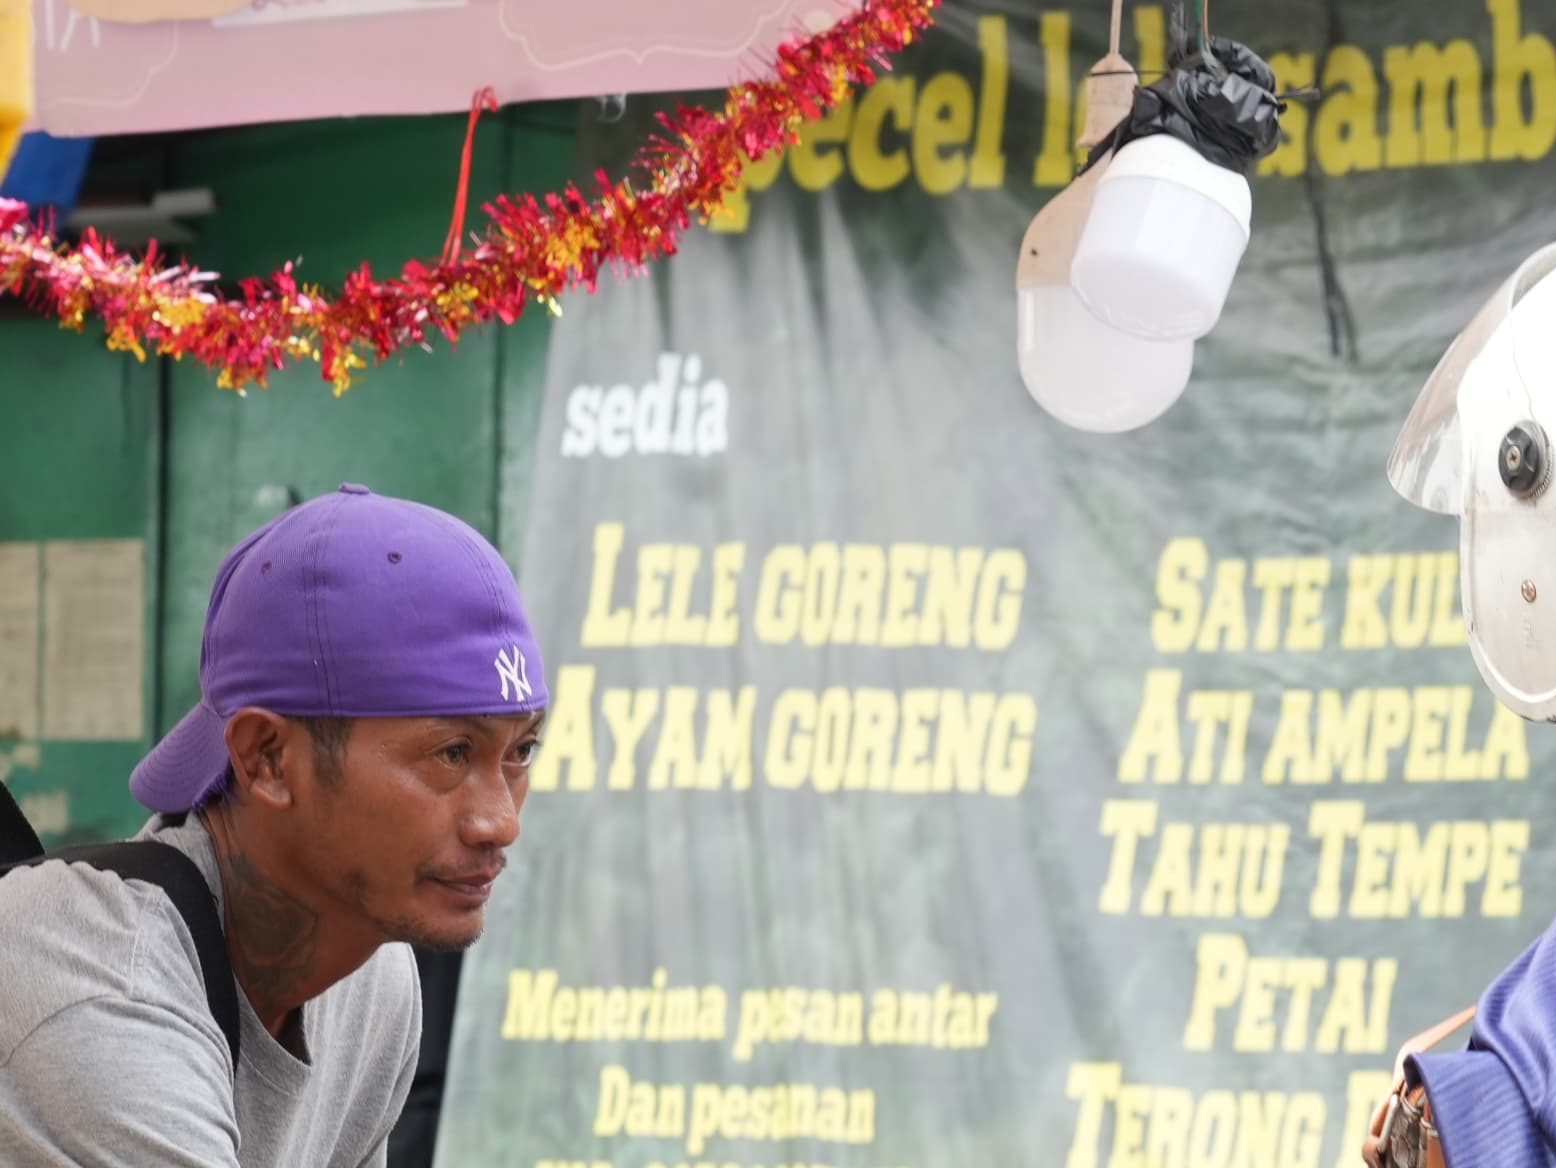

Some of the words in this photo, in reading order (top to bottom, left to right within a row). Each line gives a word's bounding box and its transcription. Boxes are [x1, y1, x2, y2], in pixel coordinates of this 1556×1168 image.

[561, 352, 729, 458] sedia
[580, 522, 745, 648] LELE
[752, 542, 1026, 651] GORENG
[1151, 537, 1331, 654] SATE
[1340, 552, 1470, 649] KUL
[530, 665, 757, 792] AYAM
[762, 686, 1038, 797] GORENG
[1262, 685, 1531, 785] AMPELA
[1098, 798, 1291, 918] TAHU
[1307, 798, 1531, 920] TEMPE
[503, 969, 727, 1042] Menerima
[867, 984, 998, 1049] antar
[1183, 932, 1398, 1054] PETAI
[594, 1064, 686, 1138] Dan
